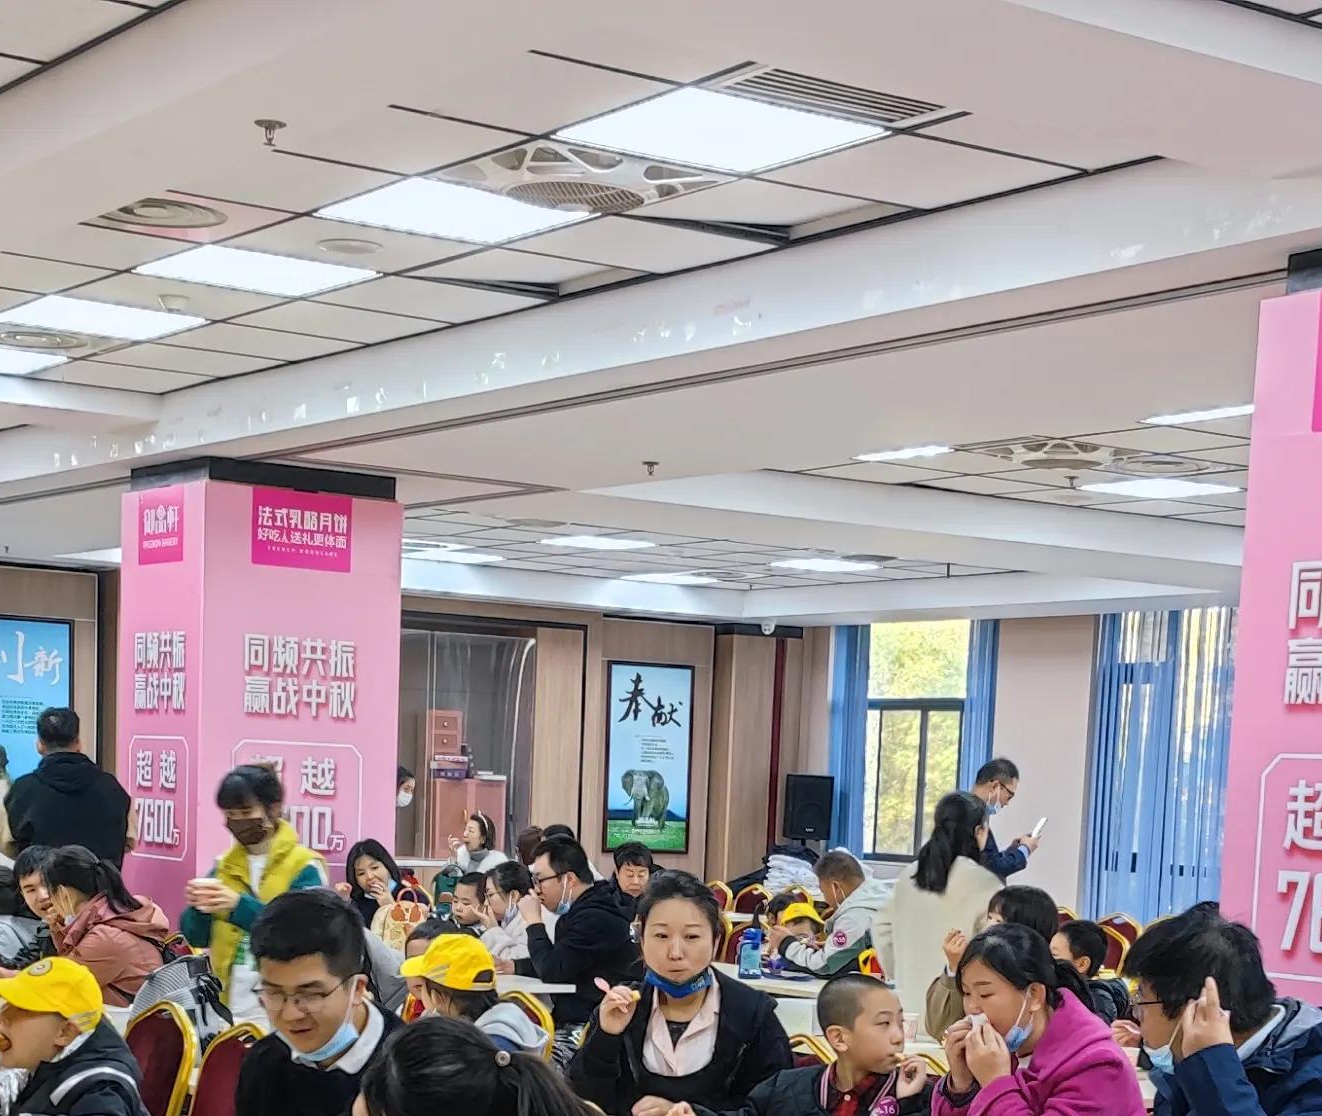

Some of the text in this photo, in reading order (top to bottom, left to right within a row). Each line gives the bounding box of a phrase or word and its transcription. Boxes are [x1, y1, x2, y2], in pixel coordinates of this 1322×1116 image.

[257, 527, 348, 549] 好吃人送礼更体面
[258, 505, 348, 534] 法式乳酪月饼
[134, 631, 186, 670] 同频共振
[244, 633, 356, 678] 同频共振
[134, 672, 186, 710] 赢战中秋
[244, 676, 356, 719] 赢战中秋
[618, 672, 683, 727] 奉献
